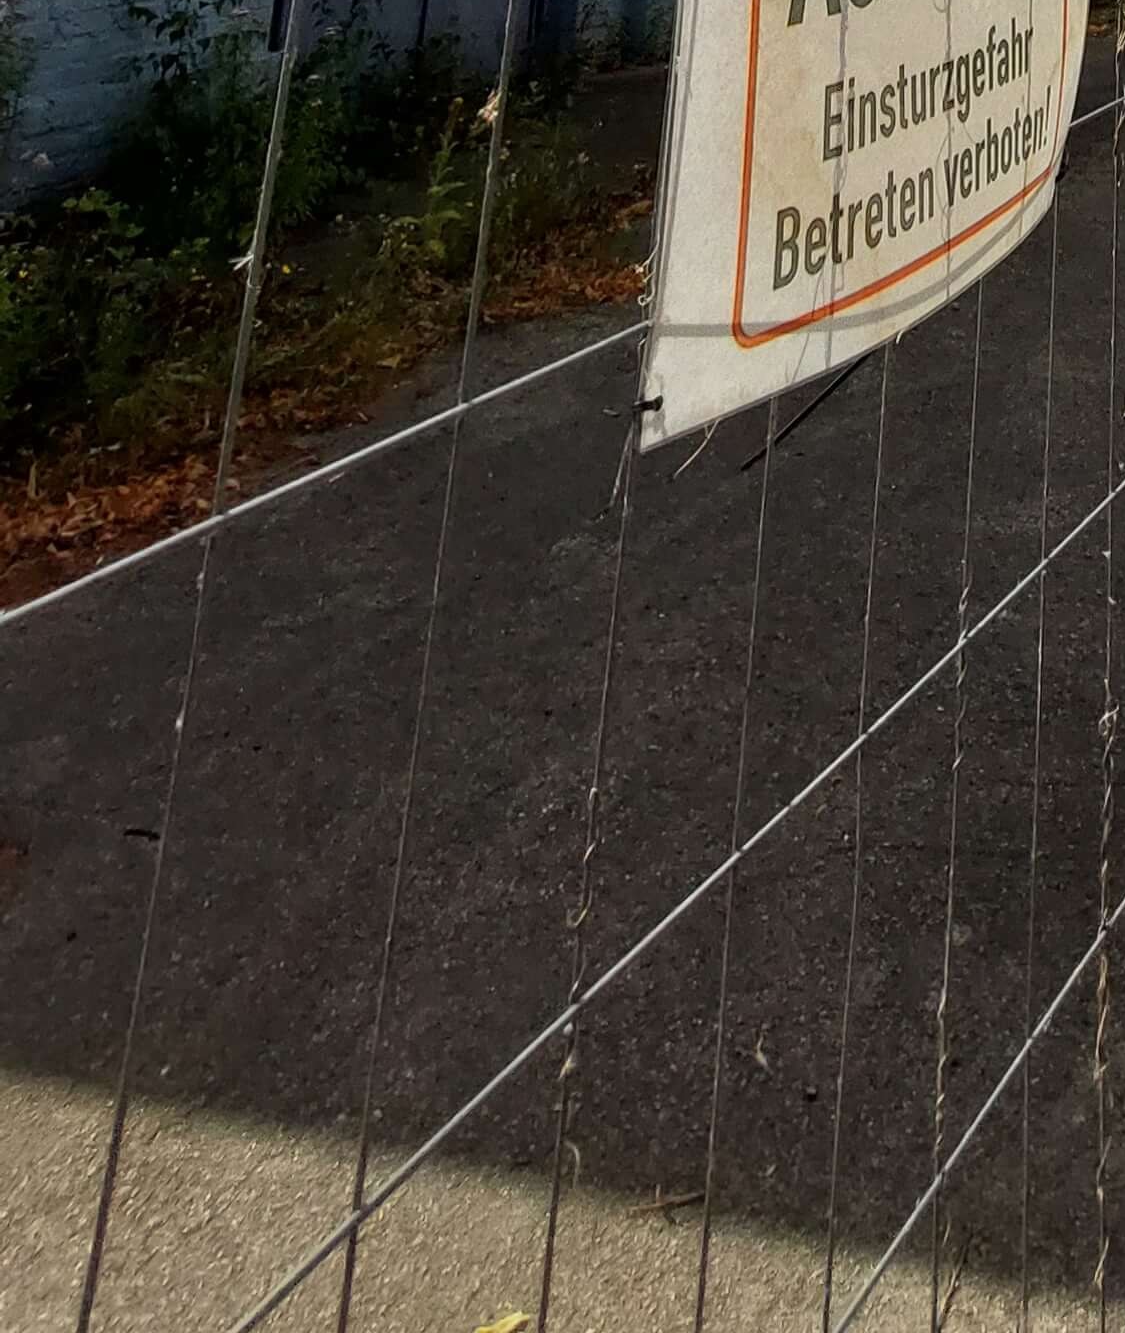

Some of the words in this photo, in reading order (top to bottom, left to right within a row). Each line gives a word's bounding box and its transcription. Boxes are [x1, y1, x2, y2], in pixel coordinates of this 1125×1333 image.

[823, 17, 1034, 162] Einsturzgefahr
[772, 166, 936, 291] Betreten
[943, 85, 1052, 208] verboten!
